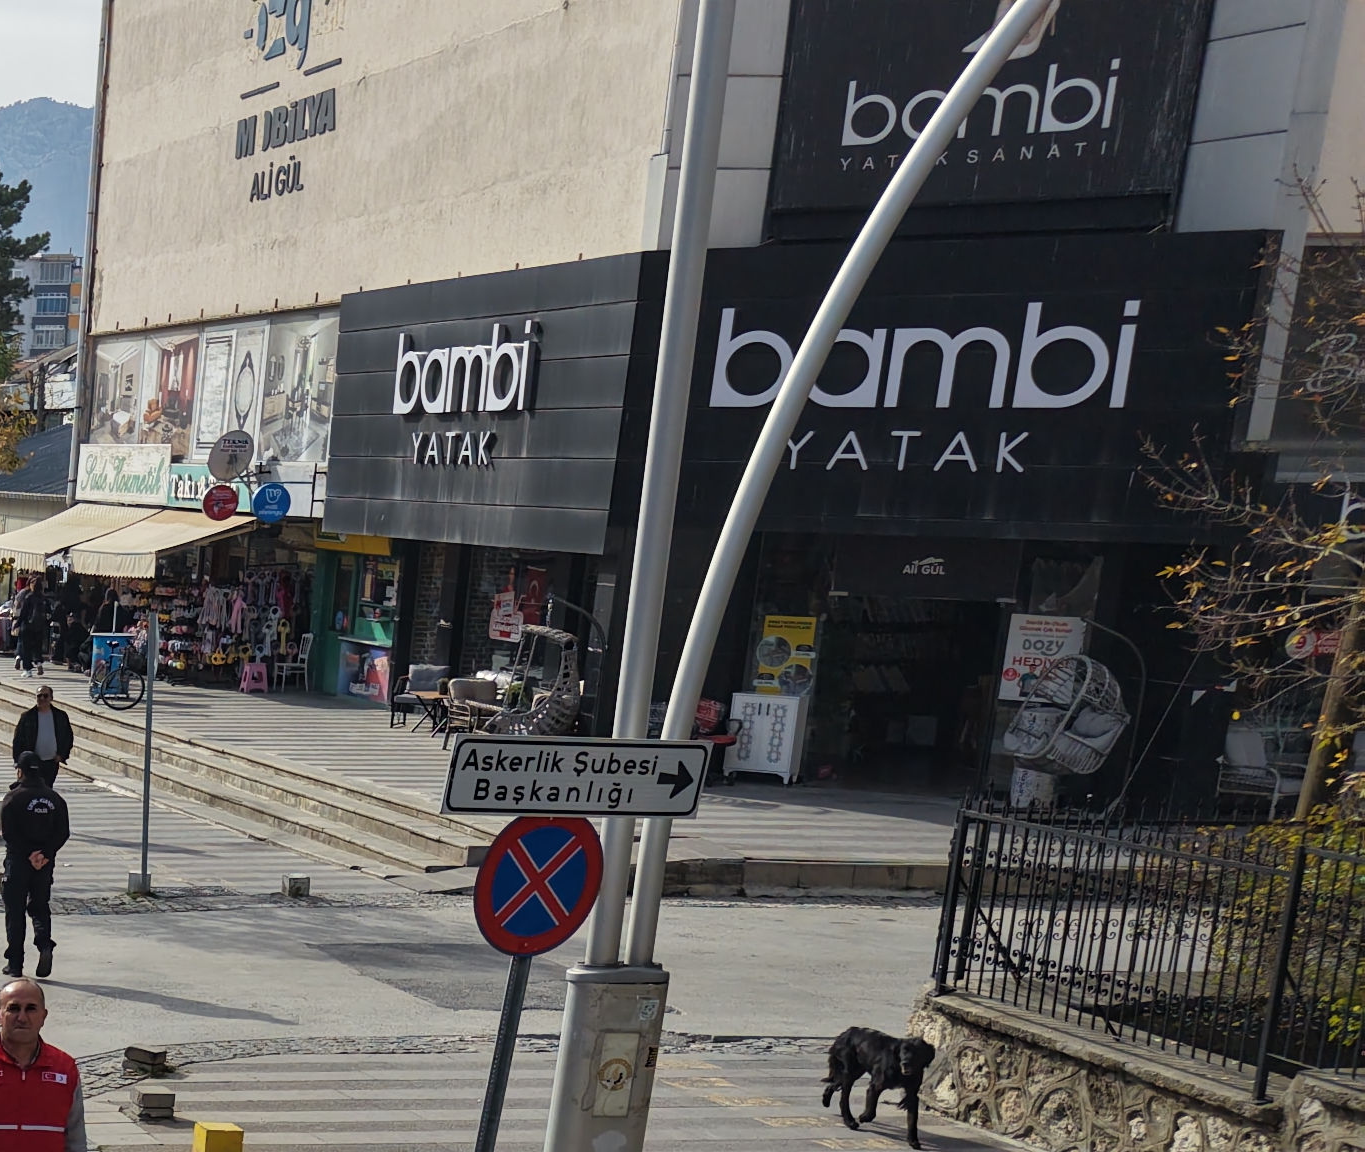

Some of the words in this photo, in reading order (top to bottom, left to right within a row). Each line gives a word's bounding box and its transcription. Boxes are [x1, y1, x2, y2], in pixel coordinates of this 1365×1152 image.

[840, 151, 948, 172] YATK
[967, 141, 1107, 164] SANATI
[275, 155, 304, 196] GÜL
[393, 320, 533, 414] bambi
[709, 300, 1141, 409] bambi
[412, 431, 491, 466] YATAK
[787, 430, 1030, 473] YATAK
[921, 563, 946, 575] GÜL
[461, 748, 565, 773] Askerlik
[572, 751, 658, 777] Şubesi
[473, 778, 633, 809] Başkanlığı
